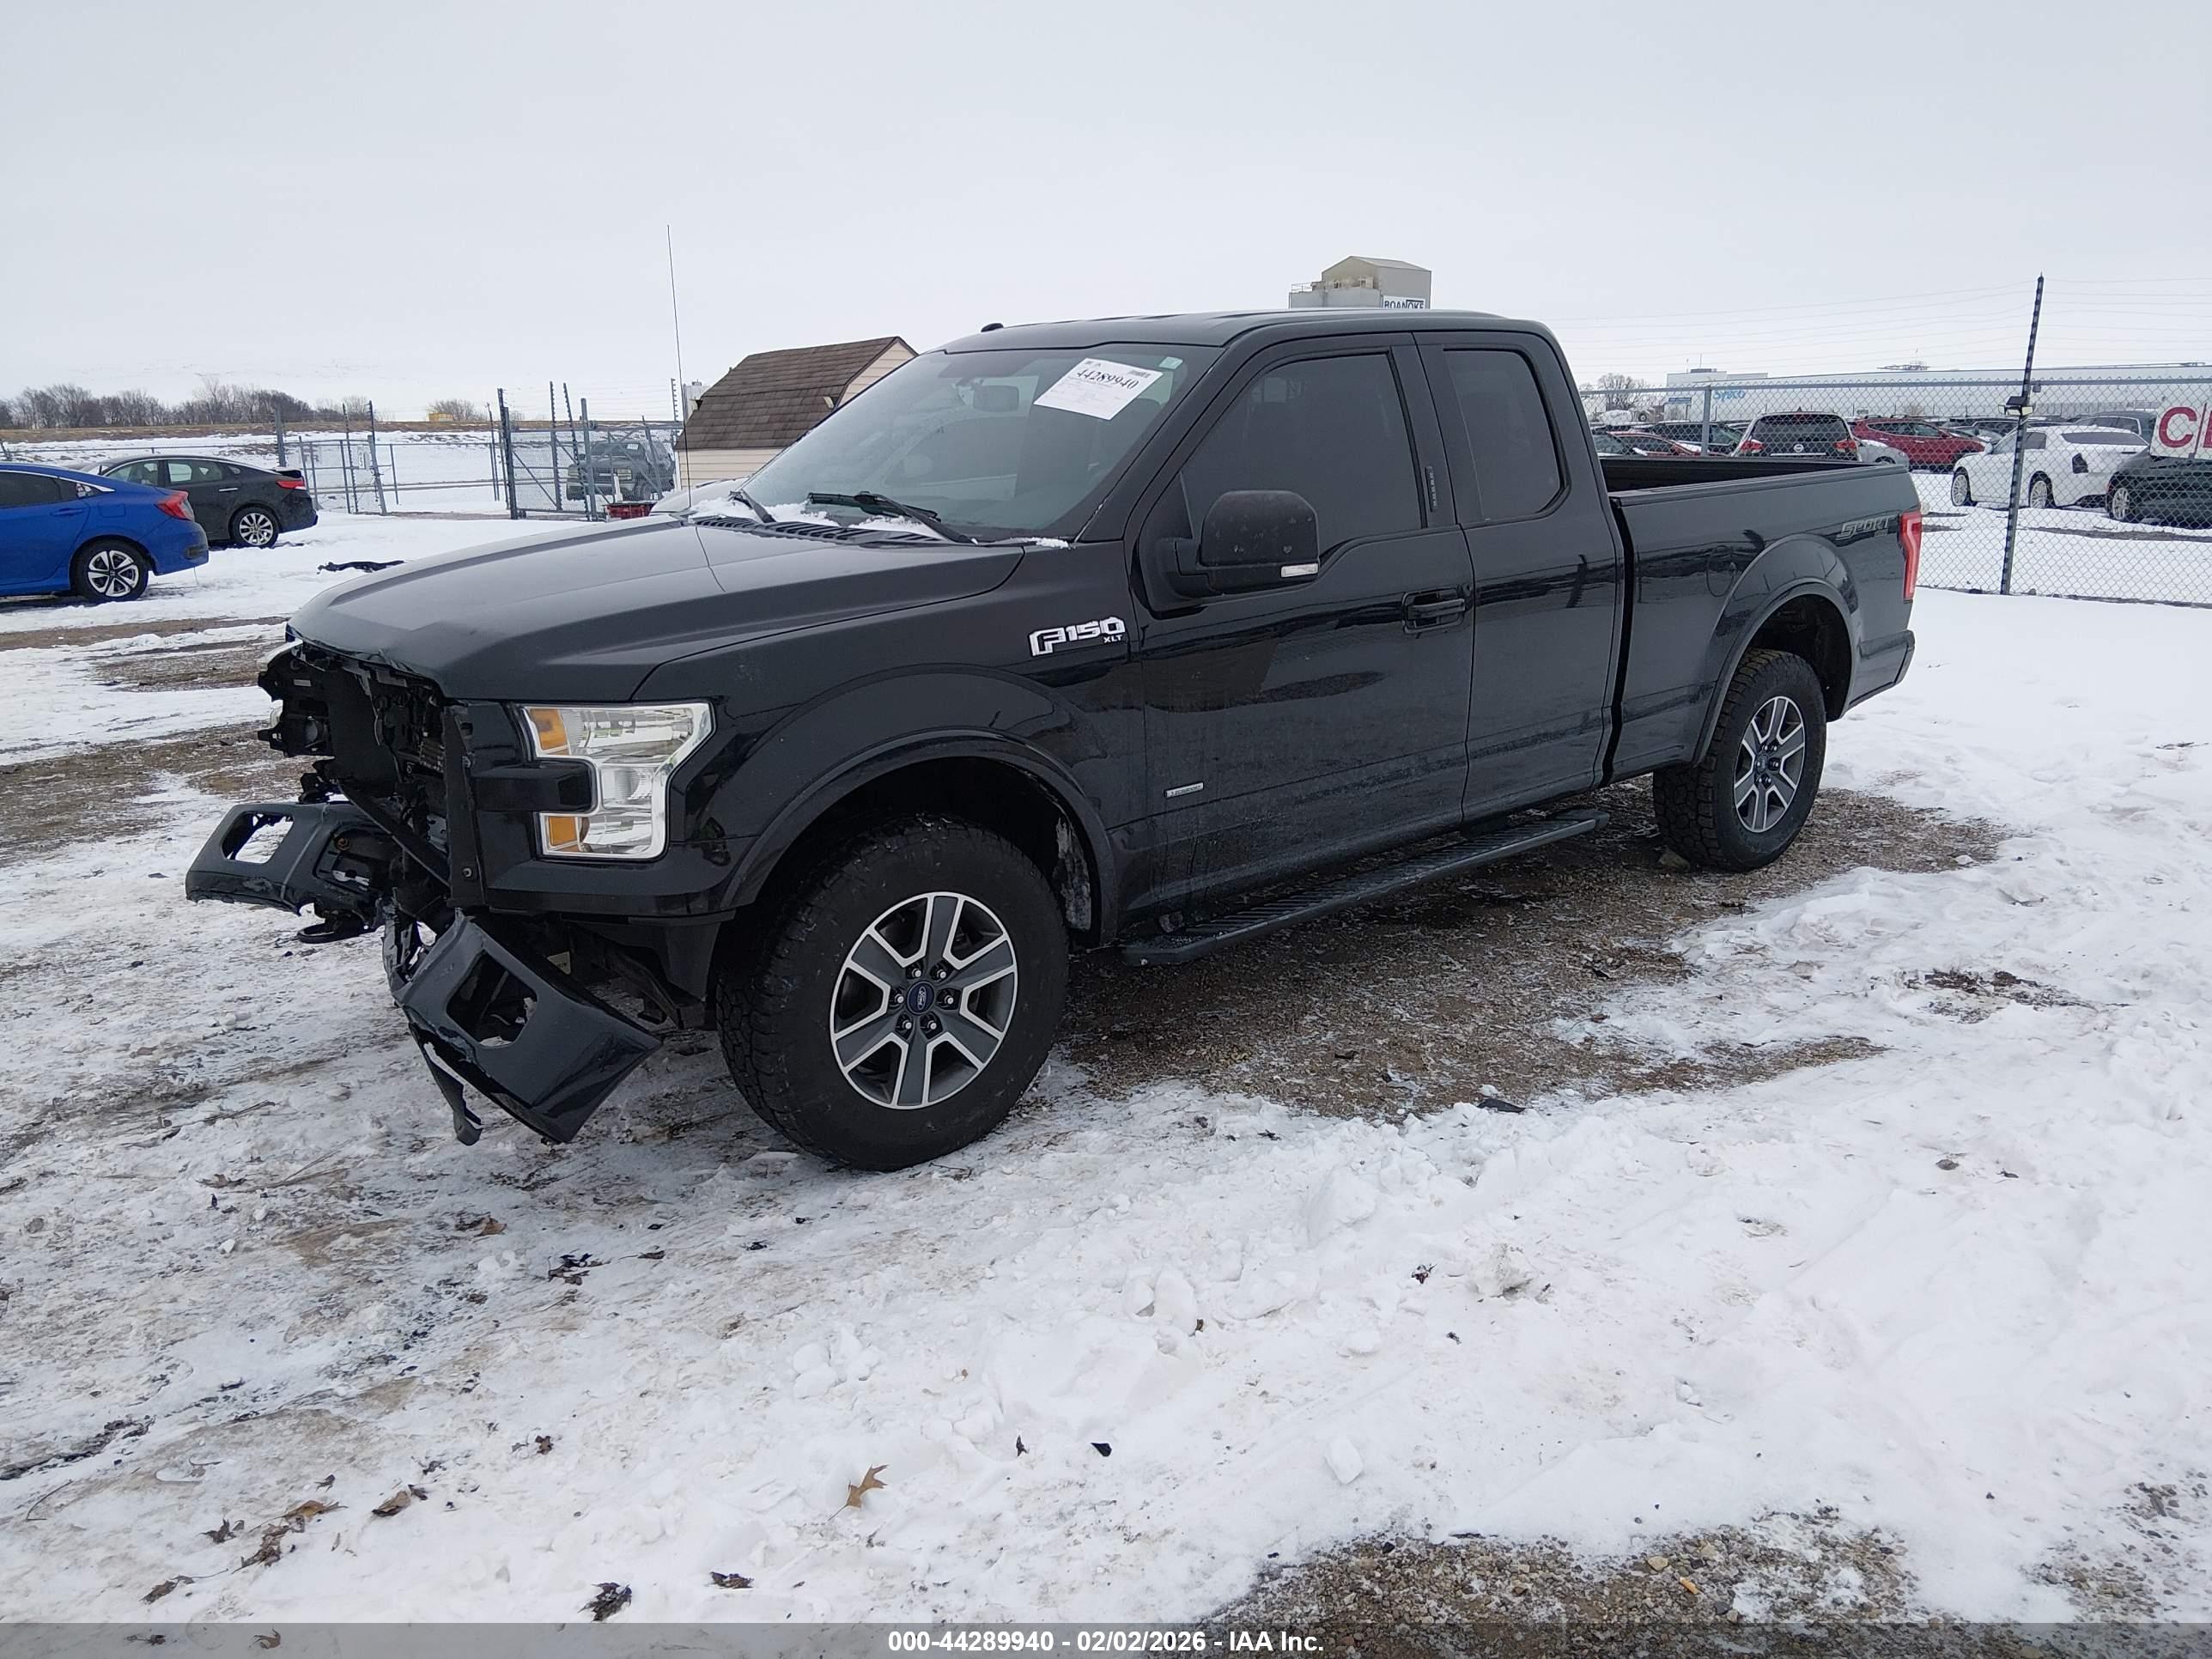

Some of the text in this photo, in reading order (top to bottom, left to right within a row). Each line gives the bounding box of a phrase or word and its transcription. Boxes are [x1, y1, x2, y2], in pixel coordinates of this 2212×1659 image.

[1077, 368, 1139, 390] 44289940
[2158, 406, 2212, 448] C
[1836, 515, 1896, 541] SPORT
[1103, 634, 1123, 643] XLT
